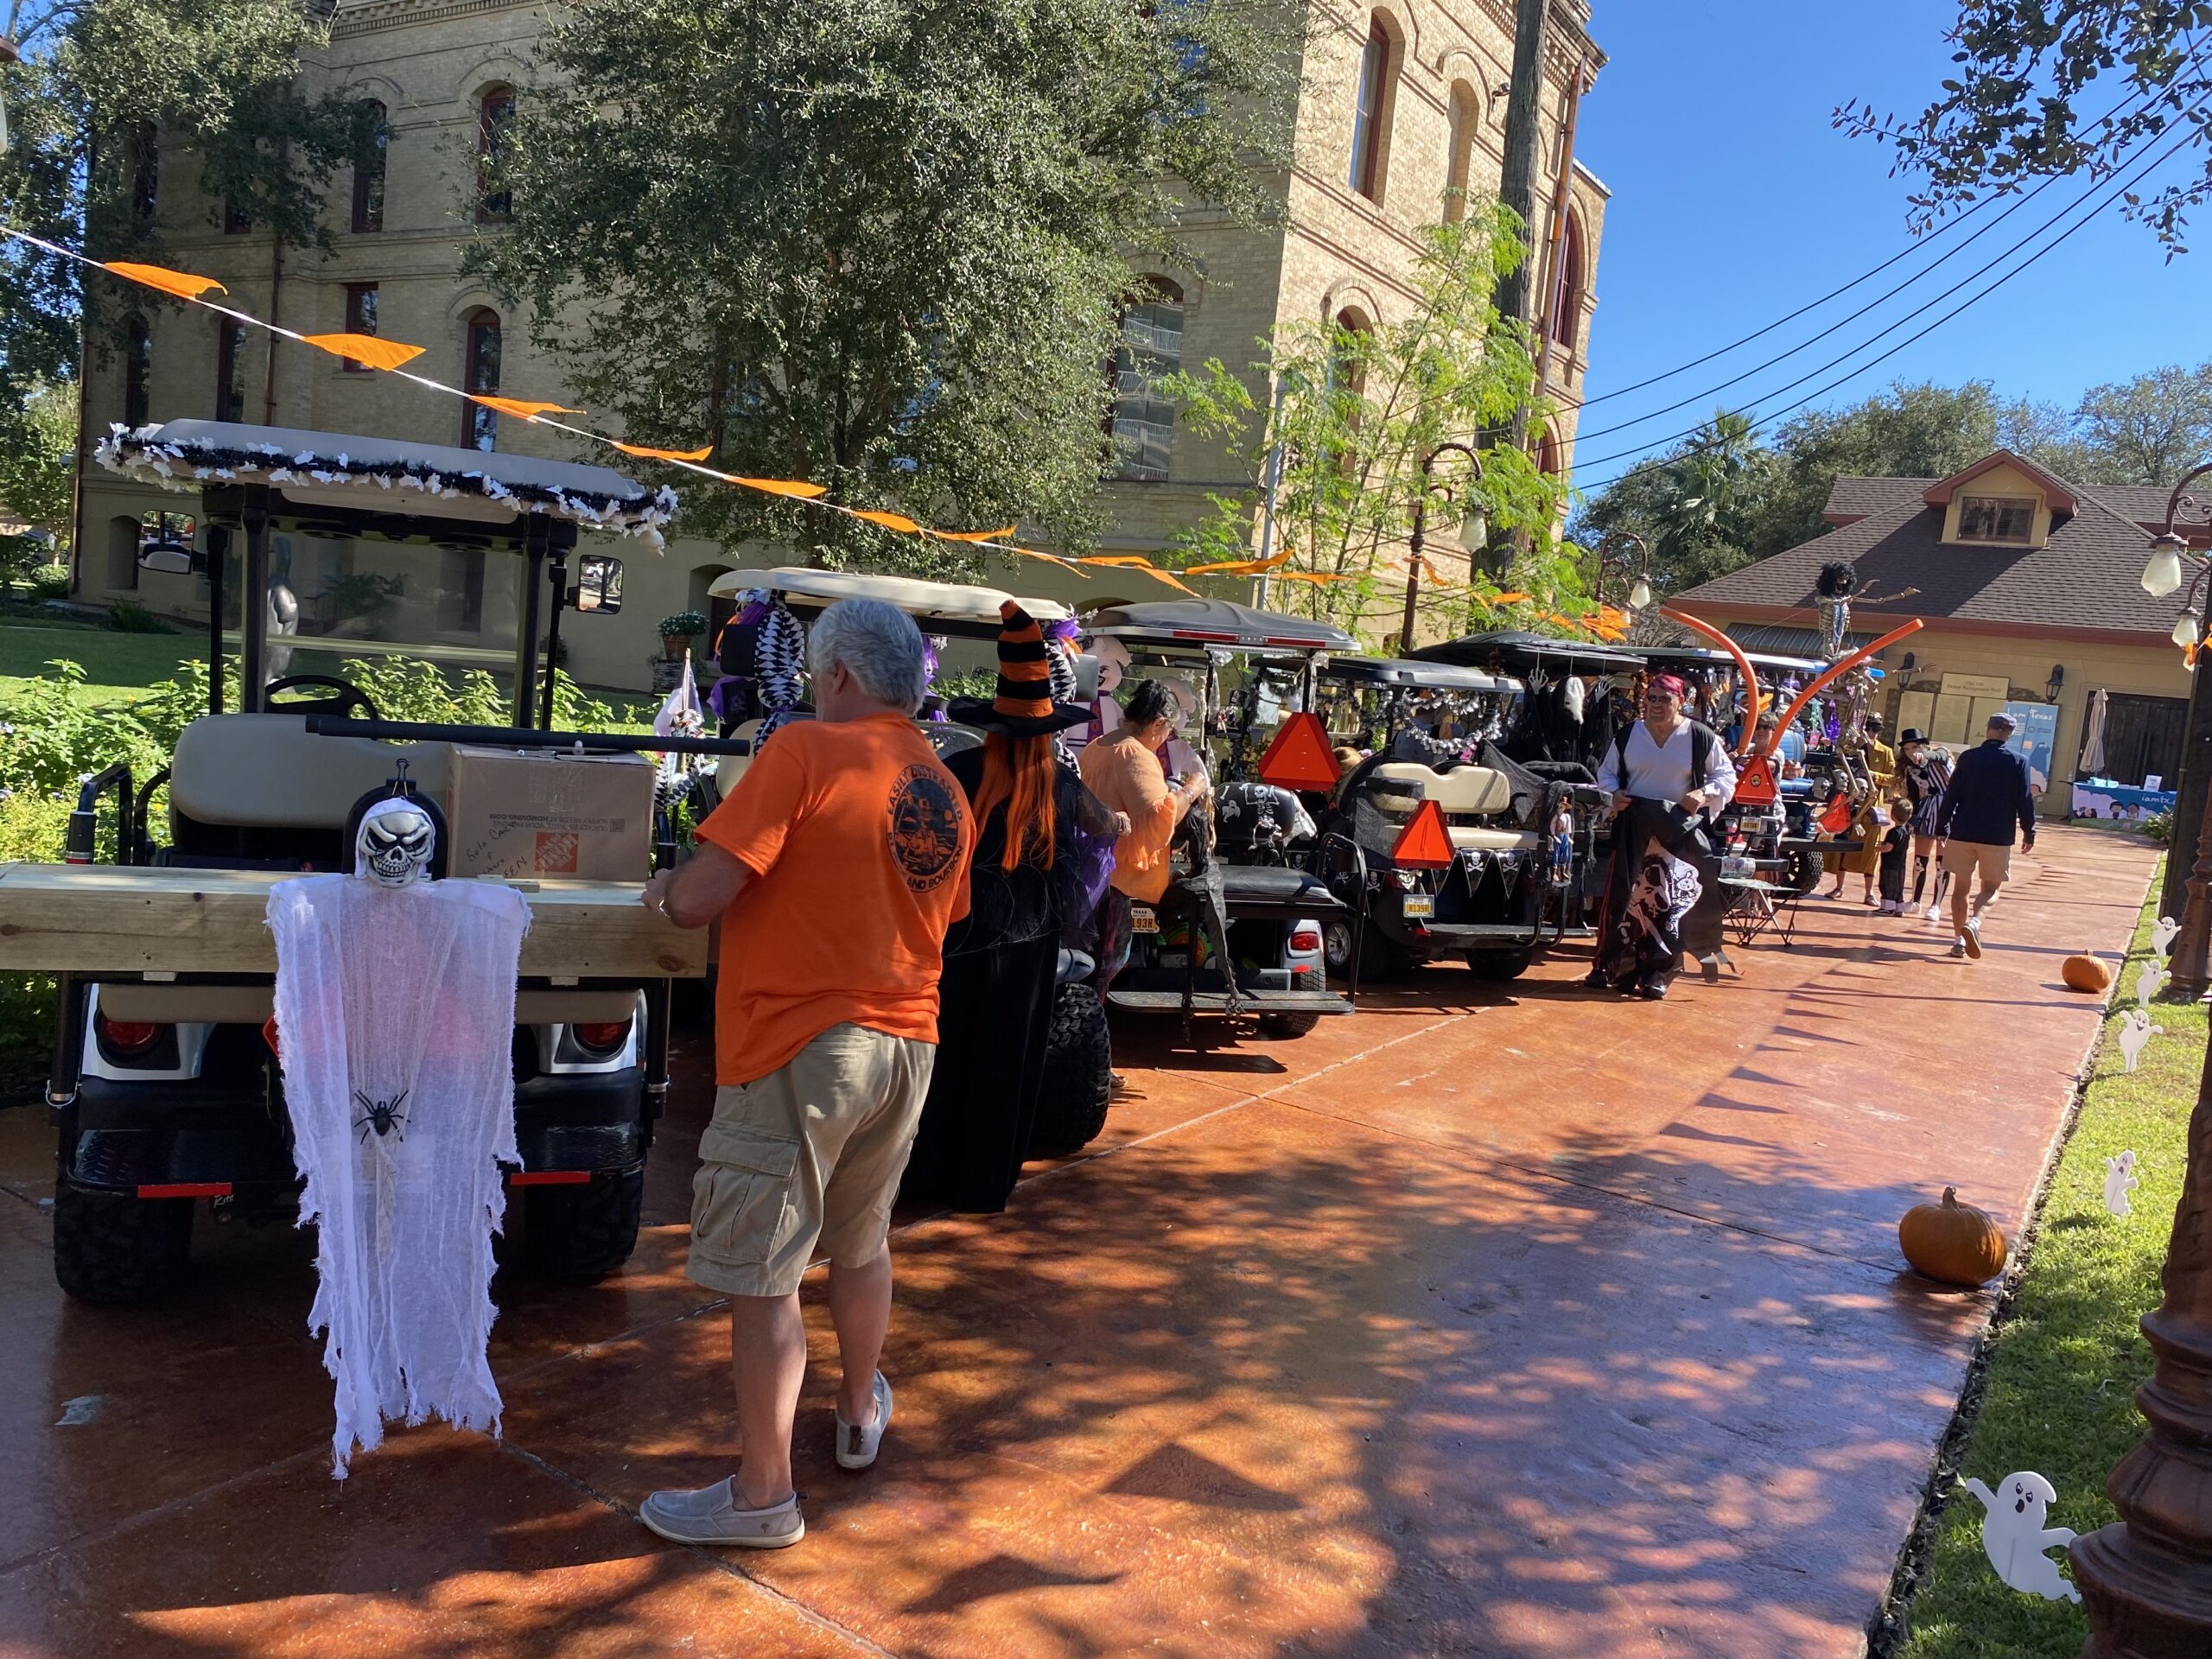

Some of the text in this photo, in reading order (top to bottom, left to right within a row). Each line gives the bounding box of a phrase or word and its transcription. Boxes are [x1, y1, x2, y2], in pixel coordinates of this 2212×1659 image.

[2030, 709, 2054, 721] Texas
[887, 768, 910, 816] EASILY
[489, 813, 548, 822] HDMOVING.COM
[906, 875, 926, 890] AND
[928, 844, 963, 888] BOURBON
